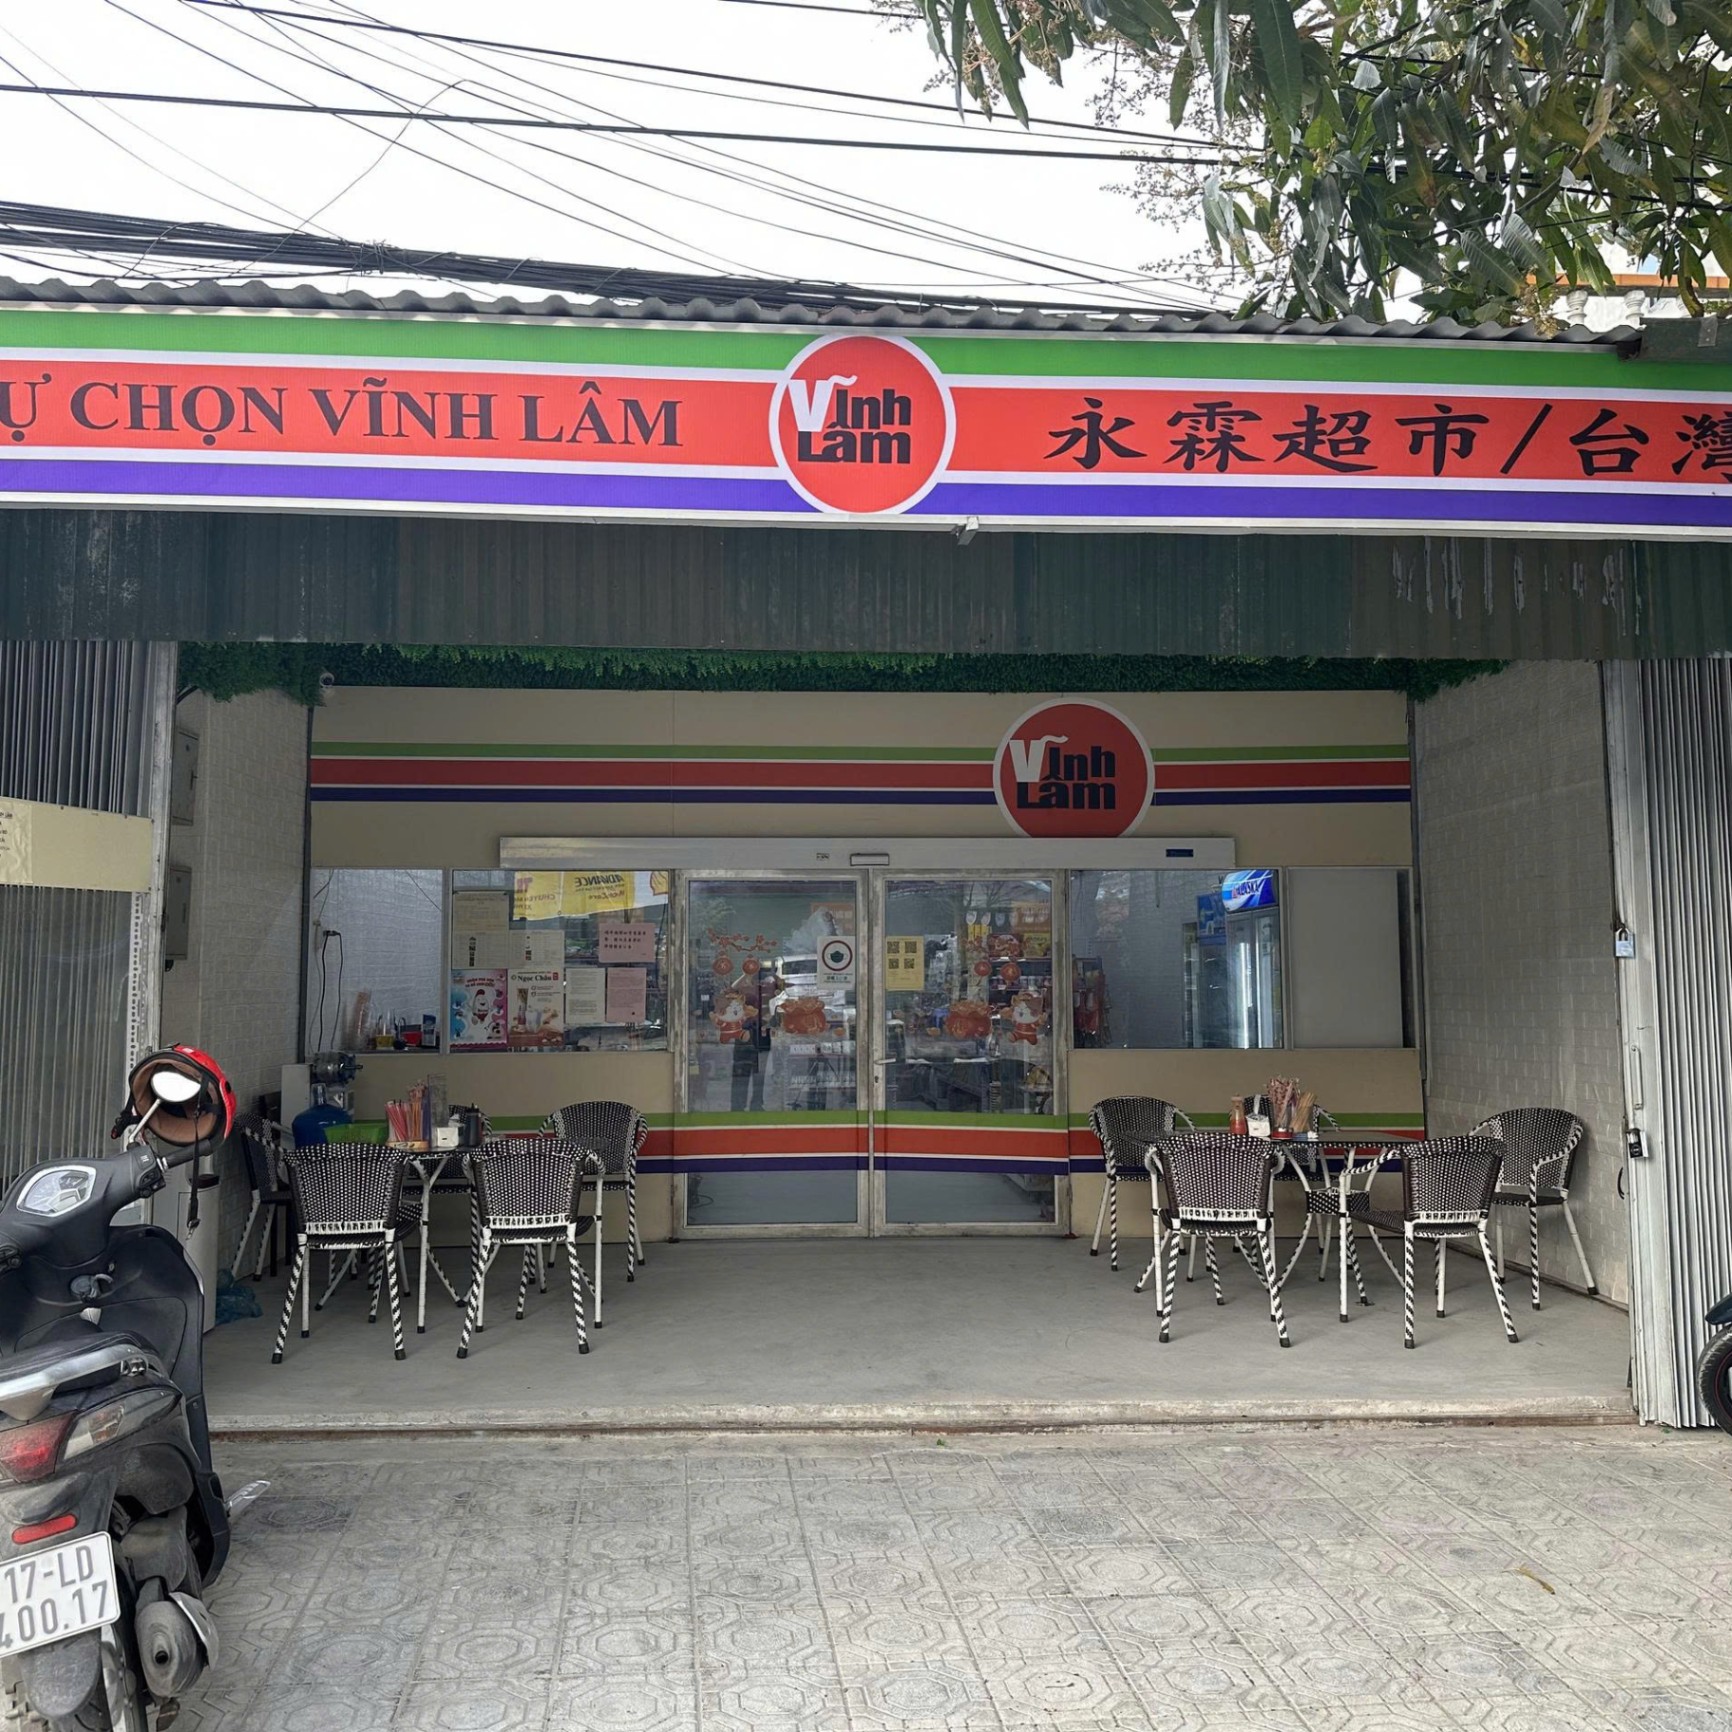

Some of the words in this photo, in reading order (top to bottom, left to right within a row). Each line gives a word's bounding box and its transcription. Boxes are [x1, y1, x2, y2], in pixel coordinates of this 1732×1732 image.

[70, 382, 288, 446] CHỌN
[308, 376, 498, 441] VĨNH
[519, 381, 683, 447] LÂM
[798, 421, 911, 464] Lâm
[1016, 774, 1117, 810] Lâm
[4, 1545, 94, 1604] 17-LD
